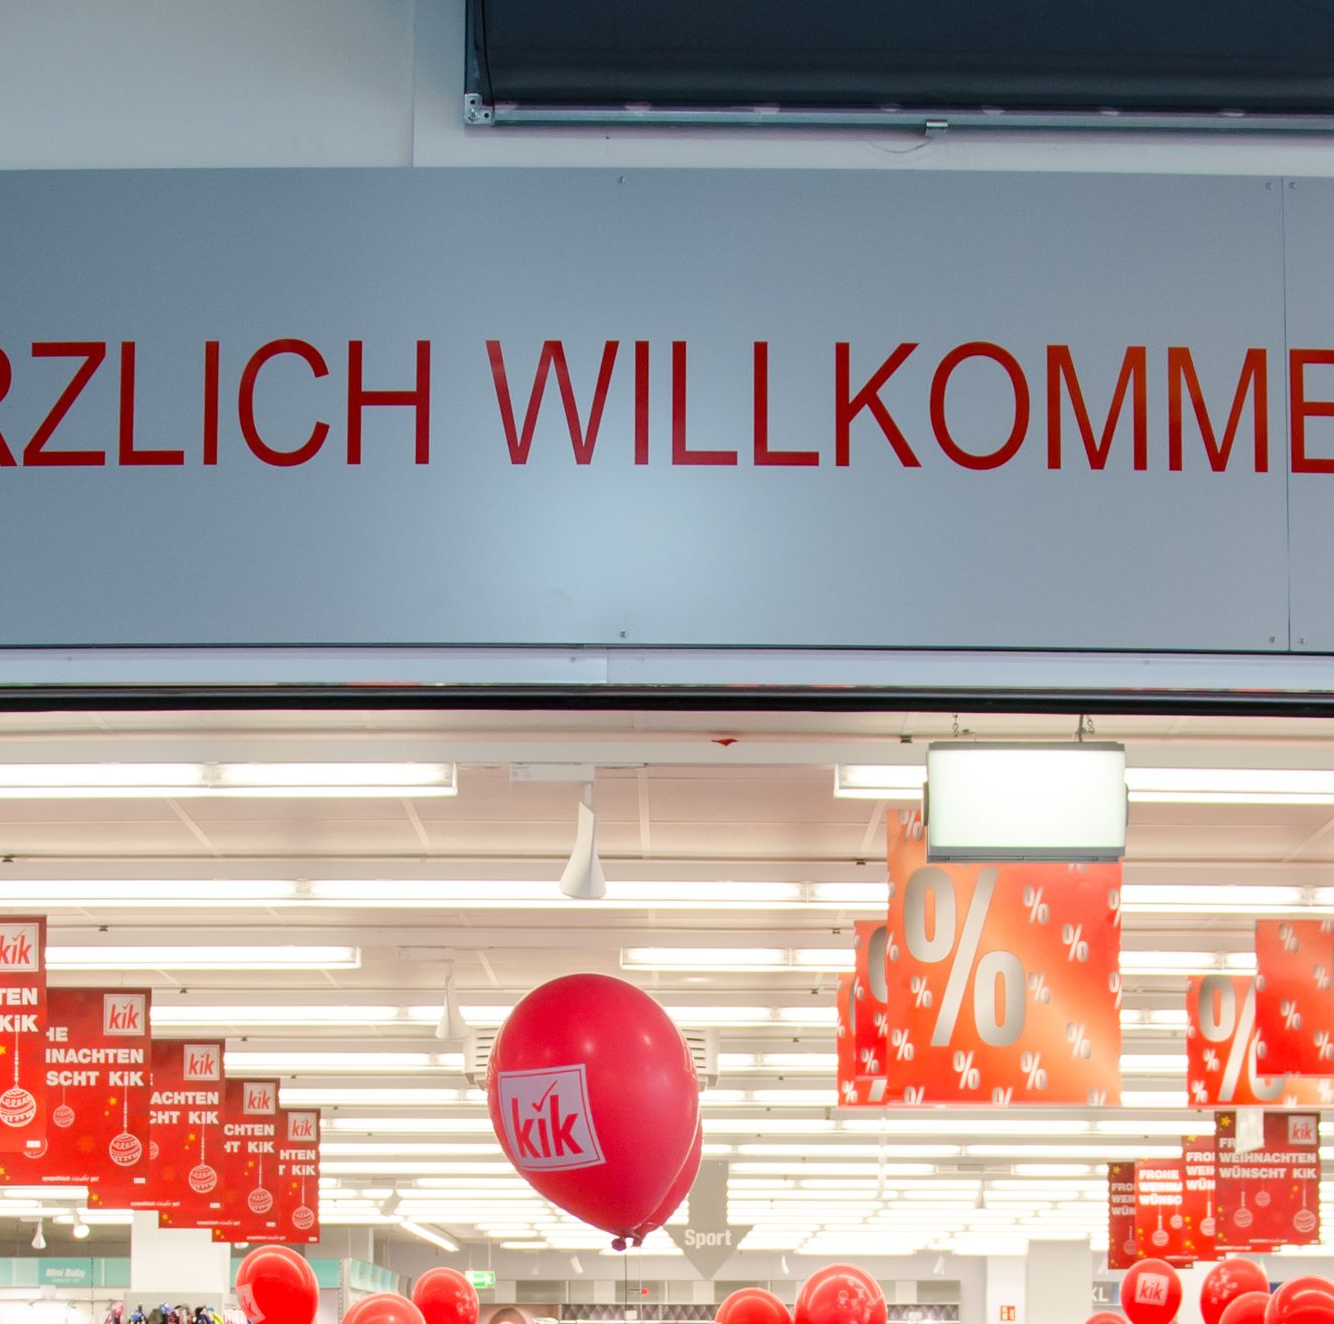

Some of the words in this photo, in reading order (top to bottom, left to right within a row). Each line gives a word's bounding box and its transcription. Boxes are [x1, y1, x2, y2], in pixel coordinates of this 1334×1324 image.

[511, 1080, 585, 1159] kik
[1218, 1153, 1317, 1163] WEIHNACHTEN
[1218, 1166, 1286, 1179] WÜNSCHT
[684, 1228, 732, 1249] Sport
